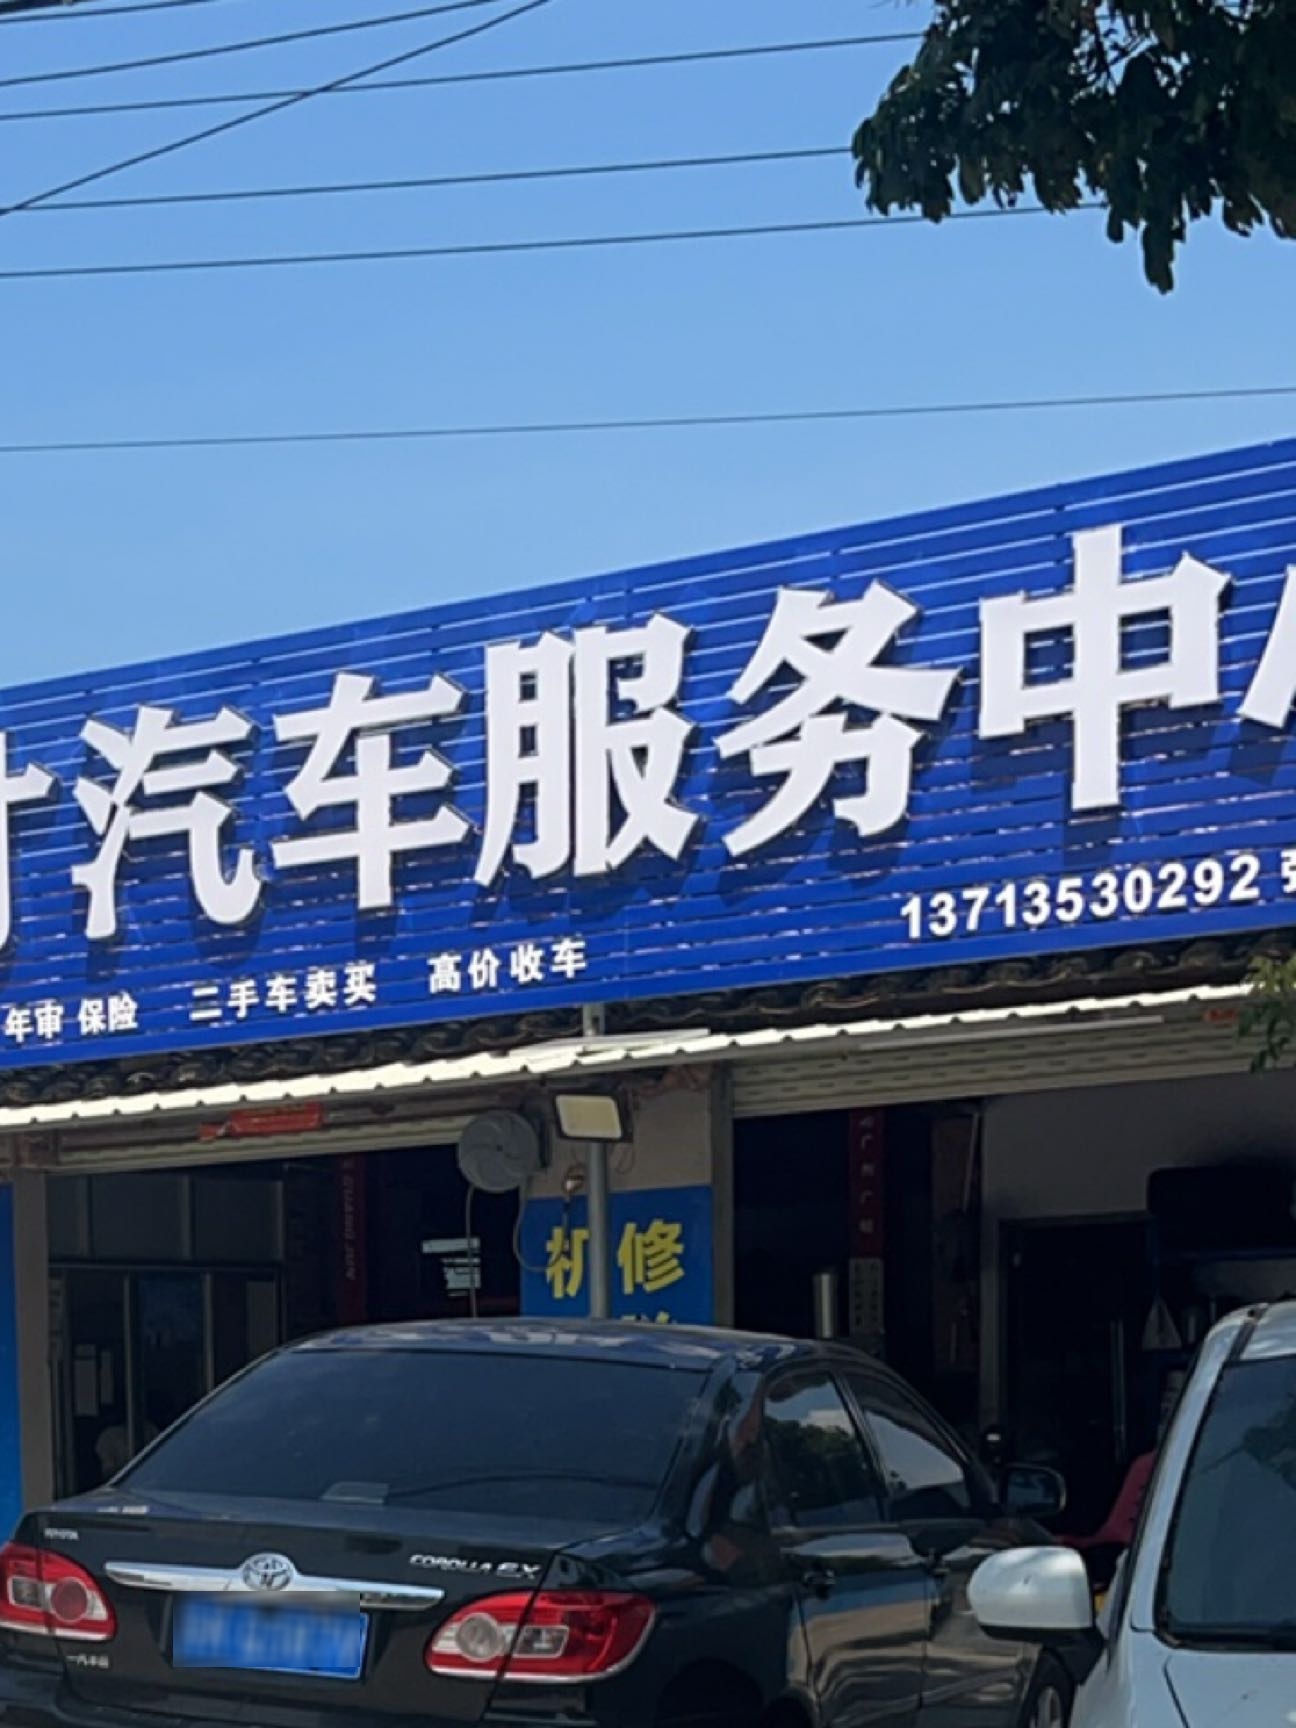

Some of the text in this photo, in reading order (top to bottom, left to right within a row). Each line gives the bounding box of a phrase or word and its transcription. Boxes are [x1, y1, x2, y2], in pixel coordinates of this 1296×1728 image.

[901, 854, 1260, 939] 13713530292
[5, 999, 64, 1042] 年审
[77, 992, 138, 1034] 保险
[190, 962, 376, 1020] 二手车卖买
[428, 937, 586, 993] 高价收车
